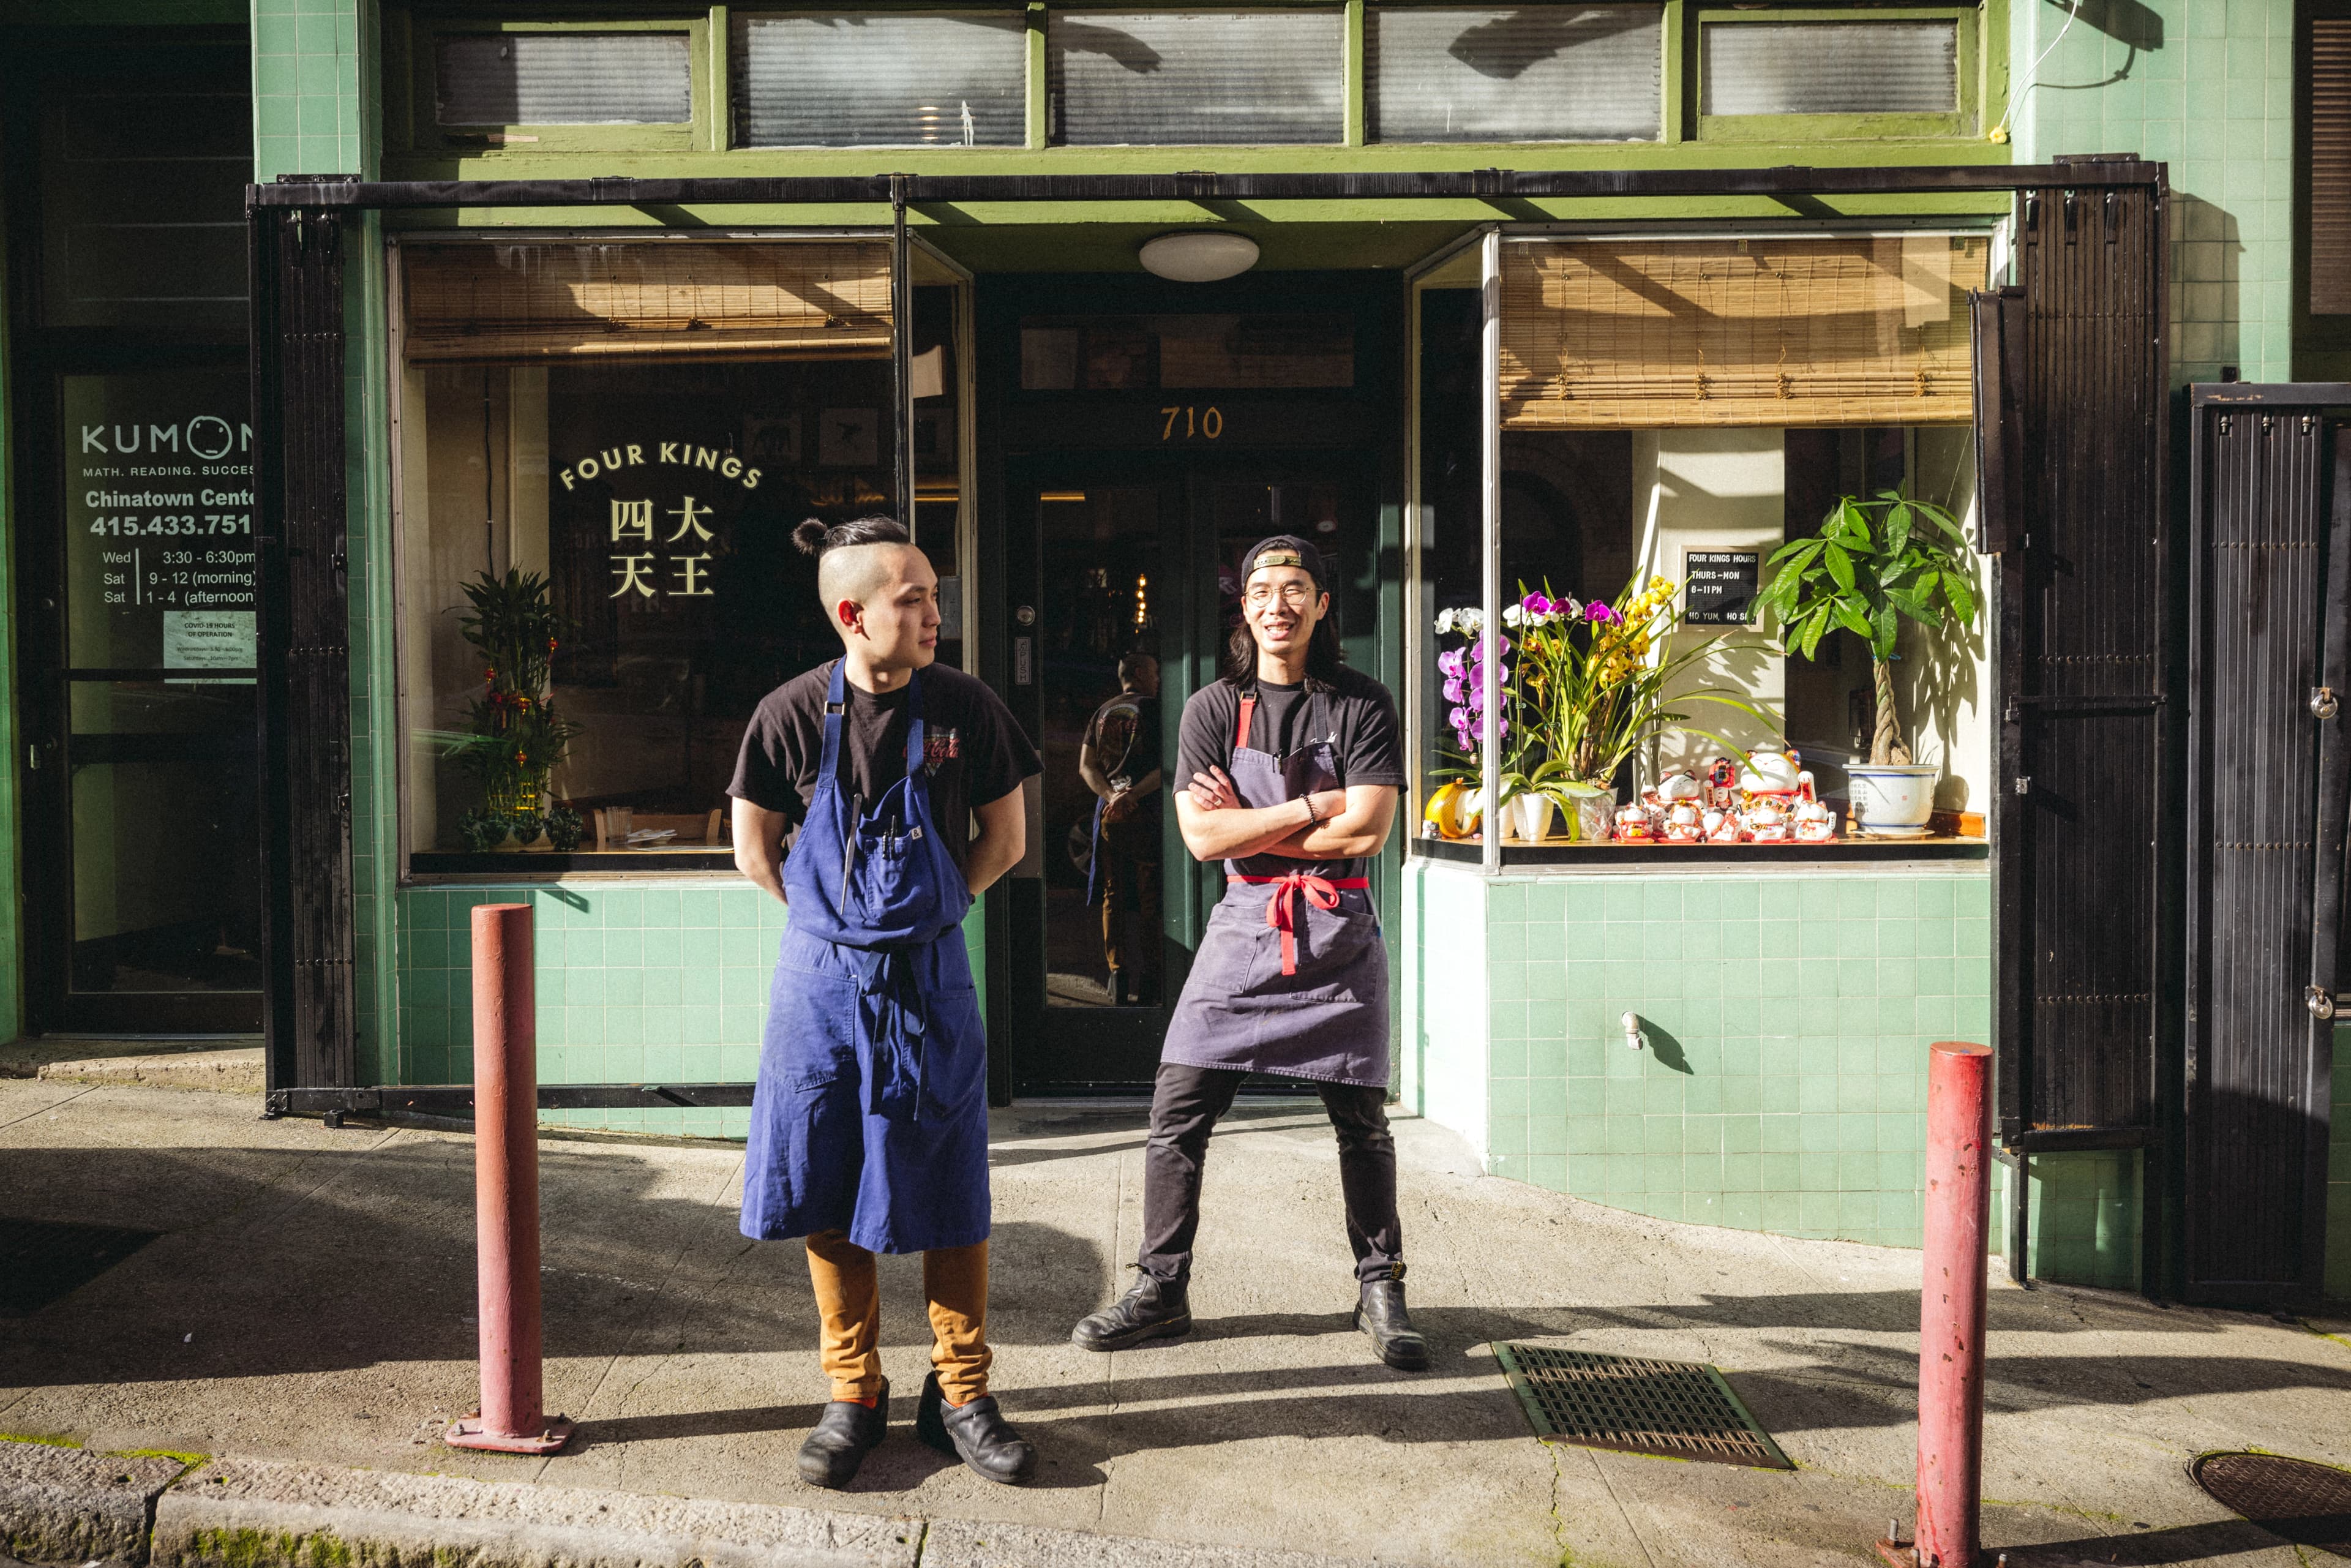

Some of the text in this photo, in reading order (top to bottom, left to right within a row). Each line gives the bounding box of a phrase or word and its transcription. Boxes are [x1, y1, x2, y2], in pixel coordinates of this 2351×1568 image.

[1161, 406, 1222, 440] 710
[83, 468, 124, 477] MATH.
[131, 467, 196, 476] READING.
[560, 441, 763, 490] FOUR KINGS
[86, 490, 193, 508] Chinatown
[90, 514, 250, 536] 415.433.751
[610, 496, 714, 542] 四大
[103, 552, 131, 563] Wed
[163, 551, 192, 564] 3:30
[206, 550, 255, 566] 6:30pm
[104, 573, 125, 585] Sat
[149, 572, 157, 584] 9
[173, 572, 188, 584] 12
[609, 552, 714, 598] 天王
[105, 591, 126, 602] Sat
[147, 591, 152, 602] 1
[168, 591, 176, 602] 4
[1703, 612, 1720, 621] YUM,
